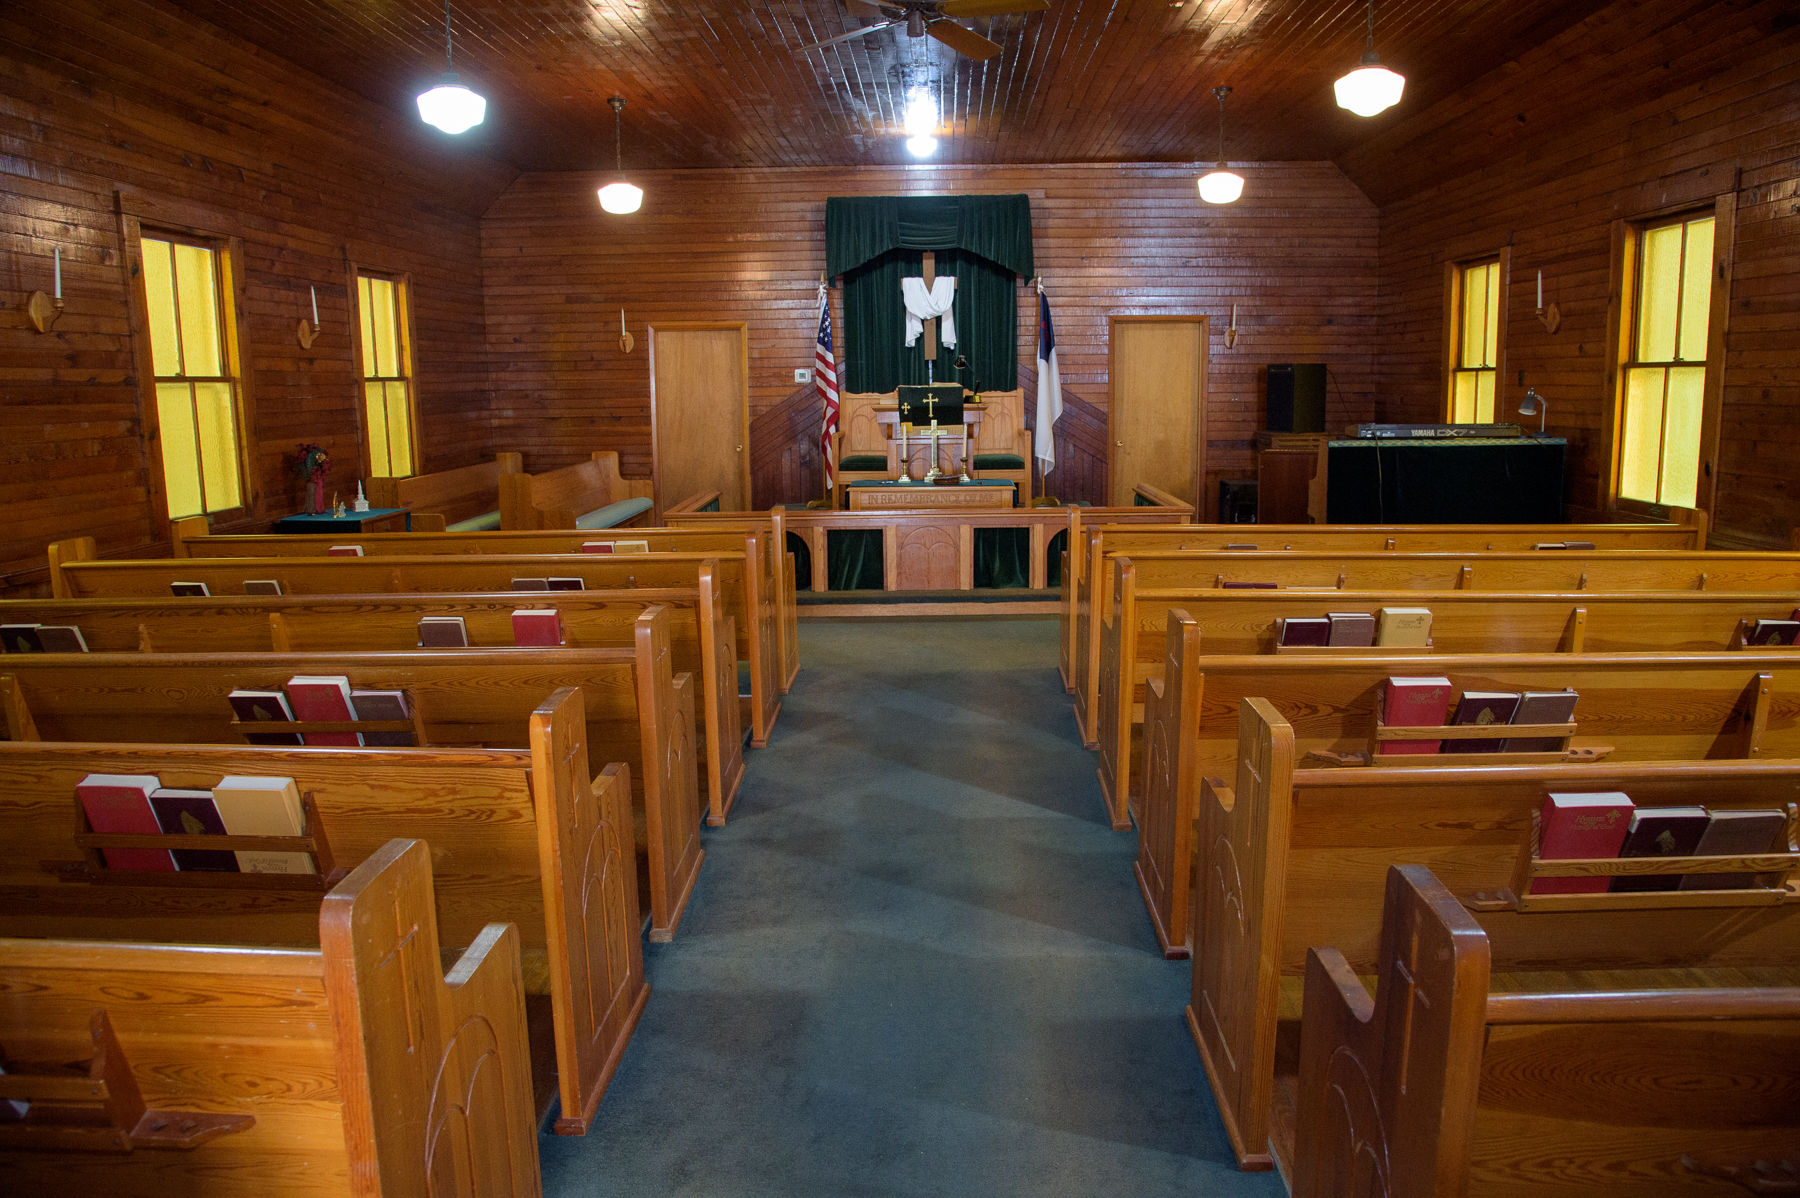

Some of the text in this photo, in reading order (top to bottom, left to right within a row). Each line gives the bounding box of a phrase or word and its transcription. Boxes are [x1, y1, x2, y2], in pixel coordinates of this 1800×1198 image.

[1411, 429, 1468, 437] YAMAHA DX7
[868, 493, 994, 505] IN REMEMBRANCE OF ME
[1575, 814, 1606, 825] Hymns
